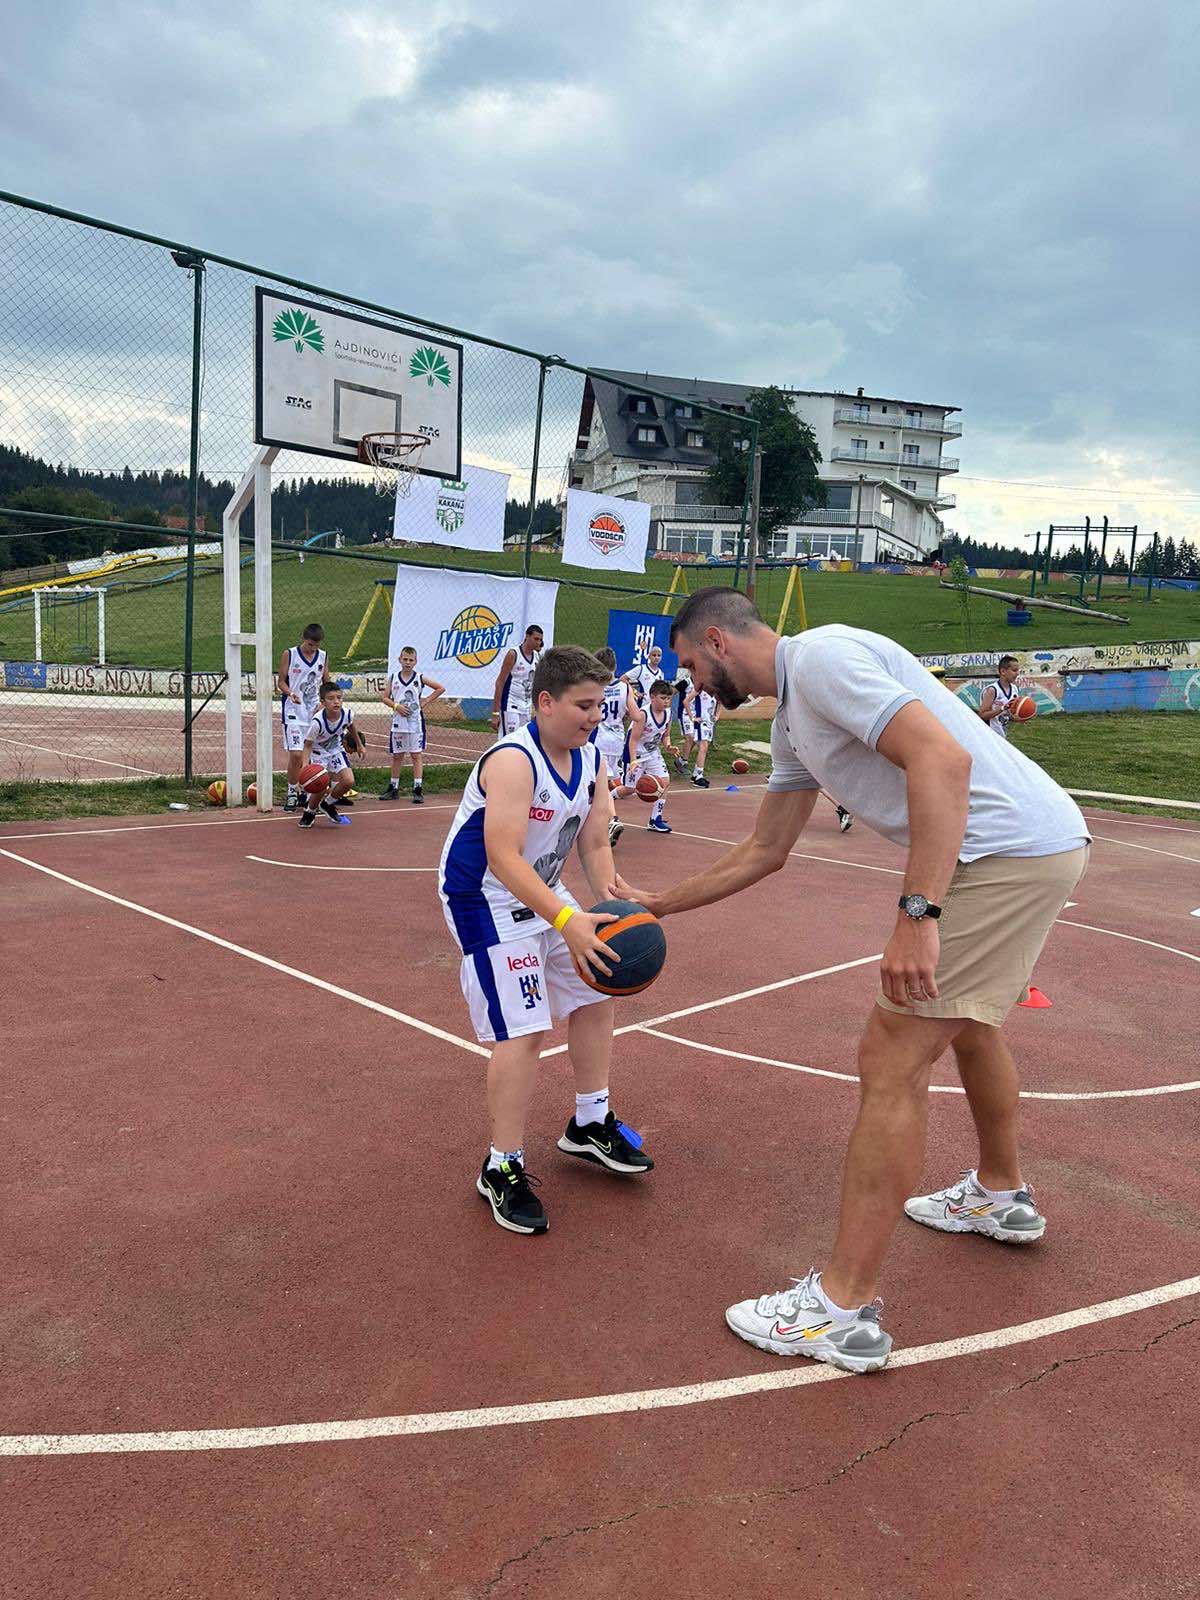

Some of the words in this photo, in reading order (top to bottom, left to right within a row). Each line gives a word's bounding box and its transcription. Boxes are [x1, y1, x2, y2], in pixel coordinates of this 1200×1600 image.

[434, 623, 513, 660] MLADOST
[601, 701, 619, 721] 34
[507, 953, 540, 971] leda
